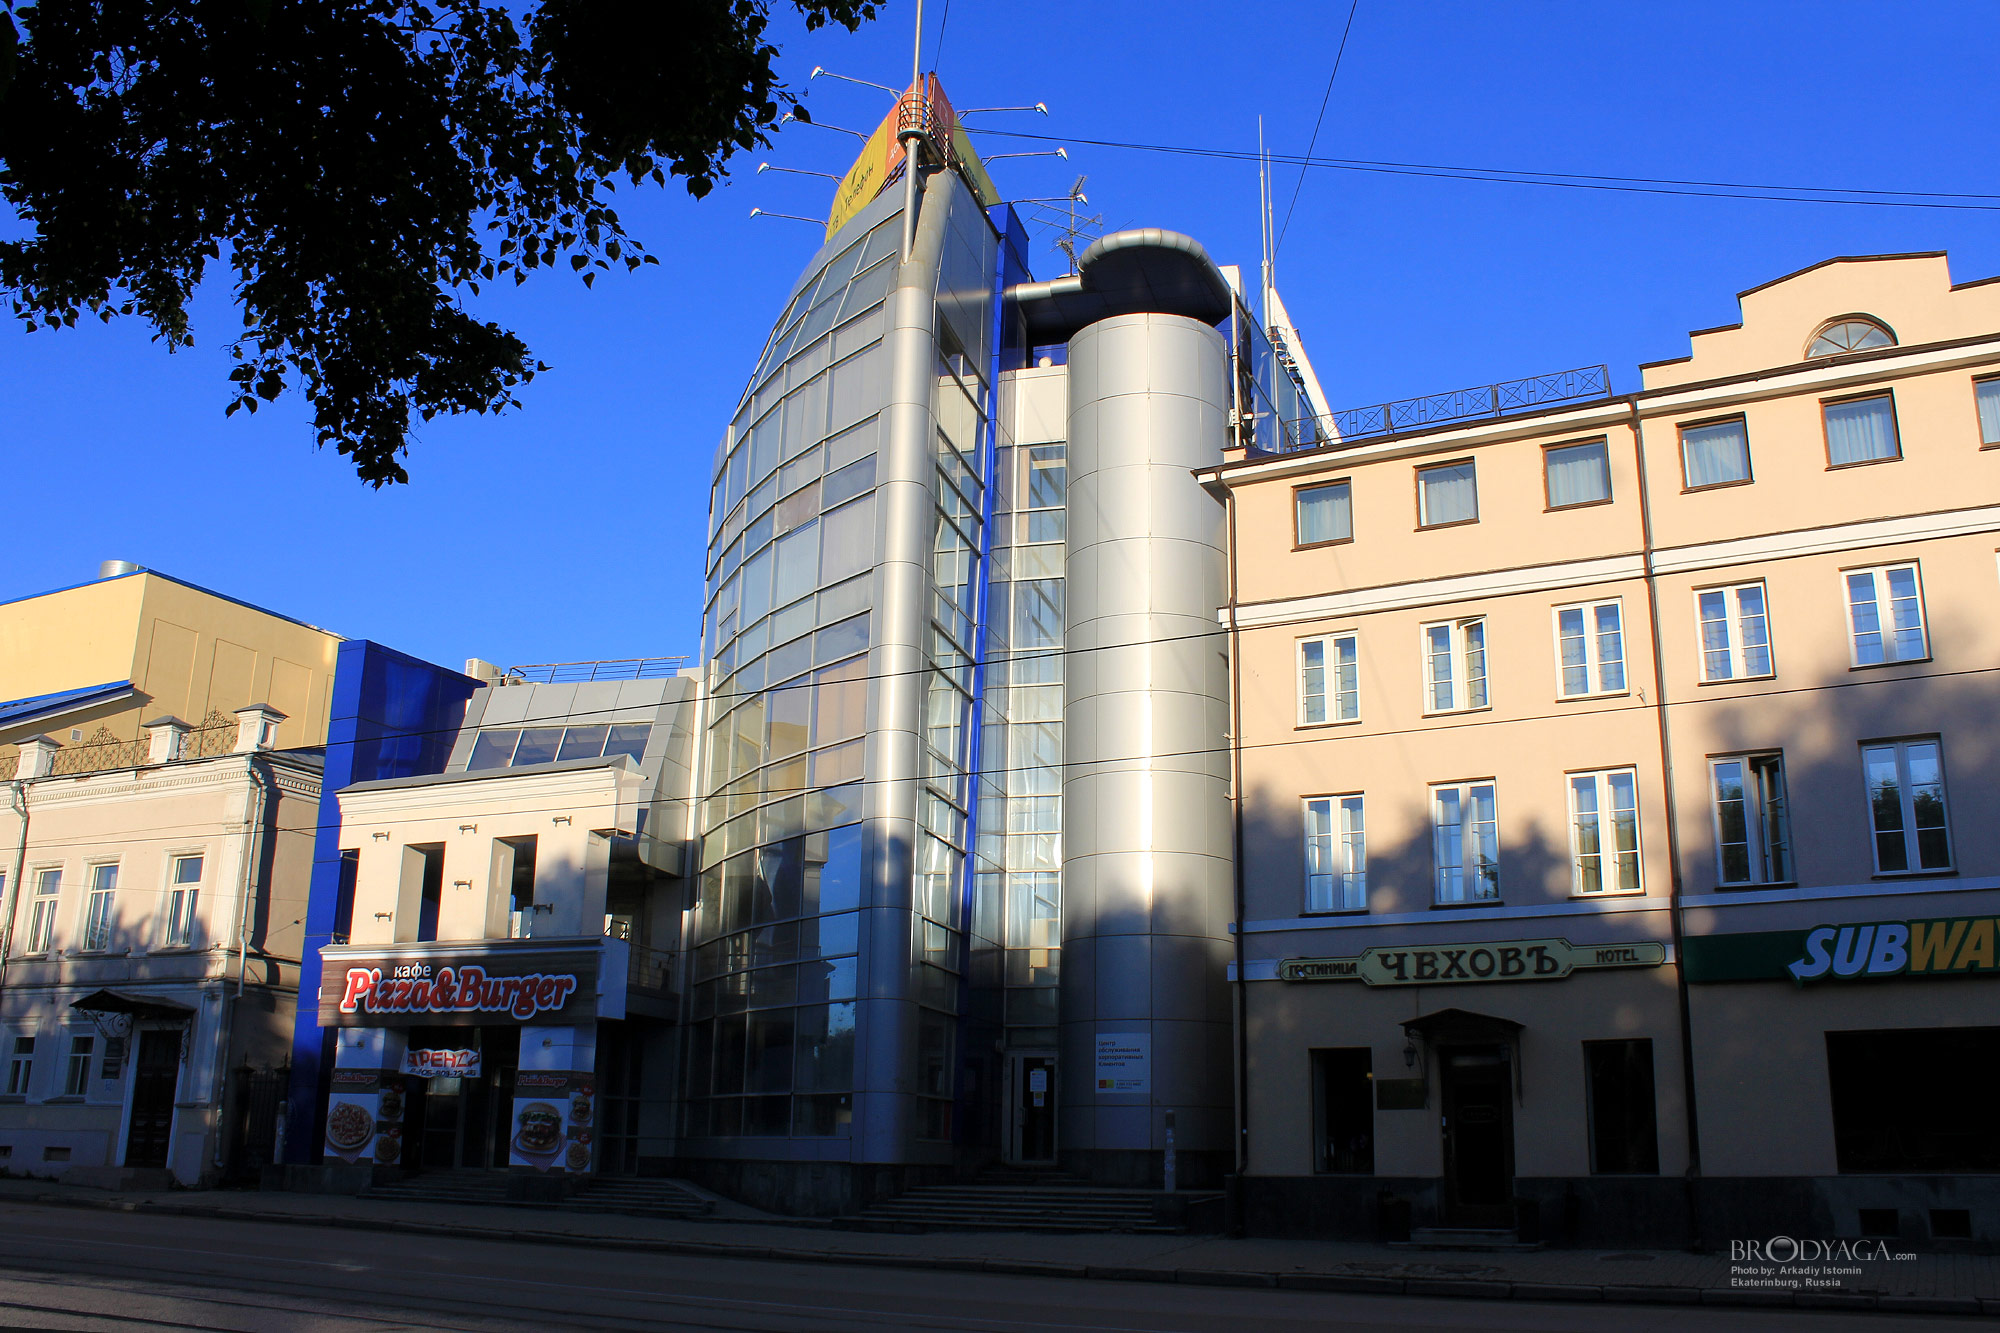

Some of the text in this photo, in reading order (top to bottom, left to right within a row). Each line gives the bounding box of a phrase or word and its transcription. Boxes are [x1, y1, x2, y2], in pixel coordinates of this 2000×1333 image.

[845, 162, 874, 211] Телефон
[394, 962, 432, 980] кафе
[1377, 945, 1560, 981] ЧЕХОВЪ
[1596, 948, 1639, 963] HOTEL
[1788, 919, 2000, 981] SUBWA
[339, 966, 577, 1020] Pizza&Burger
